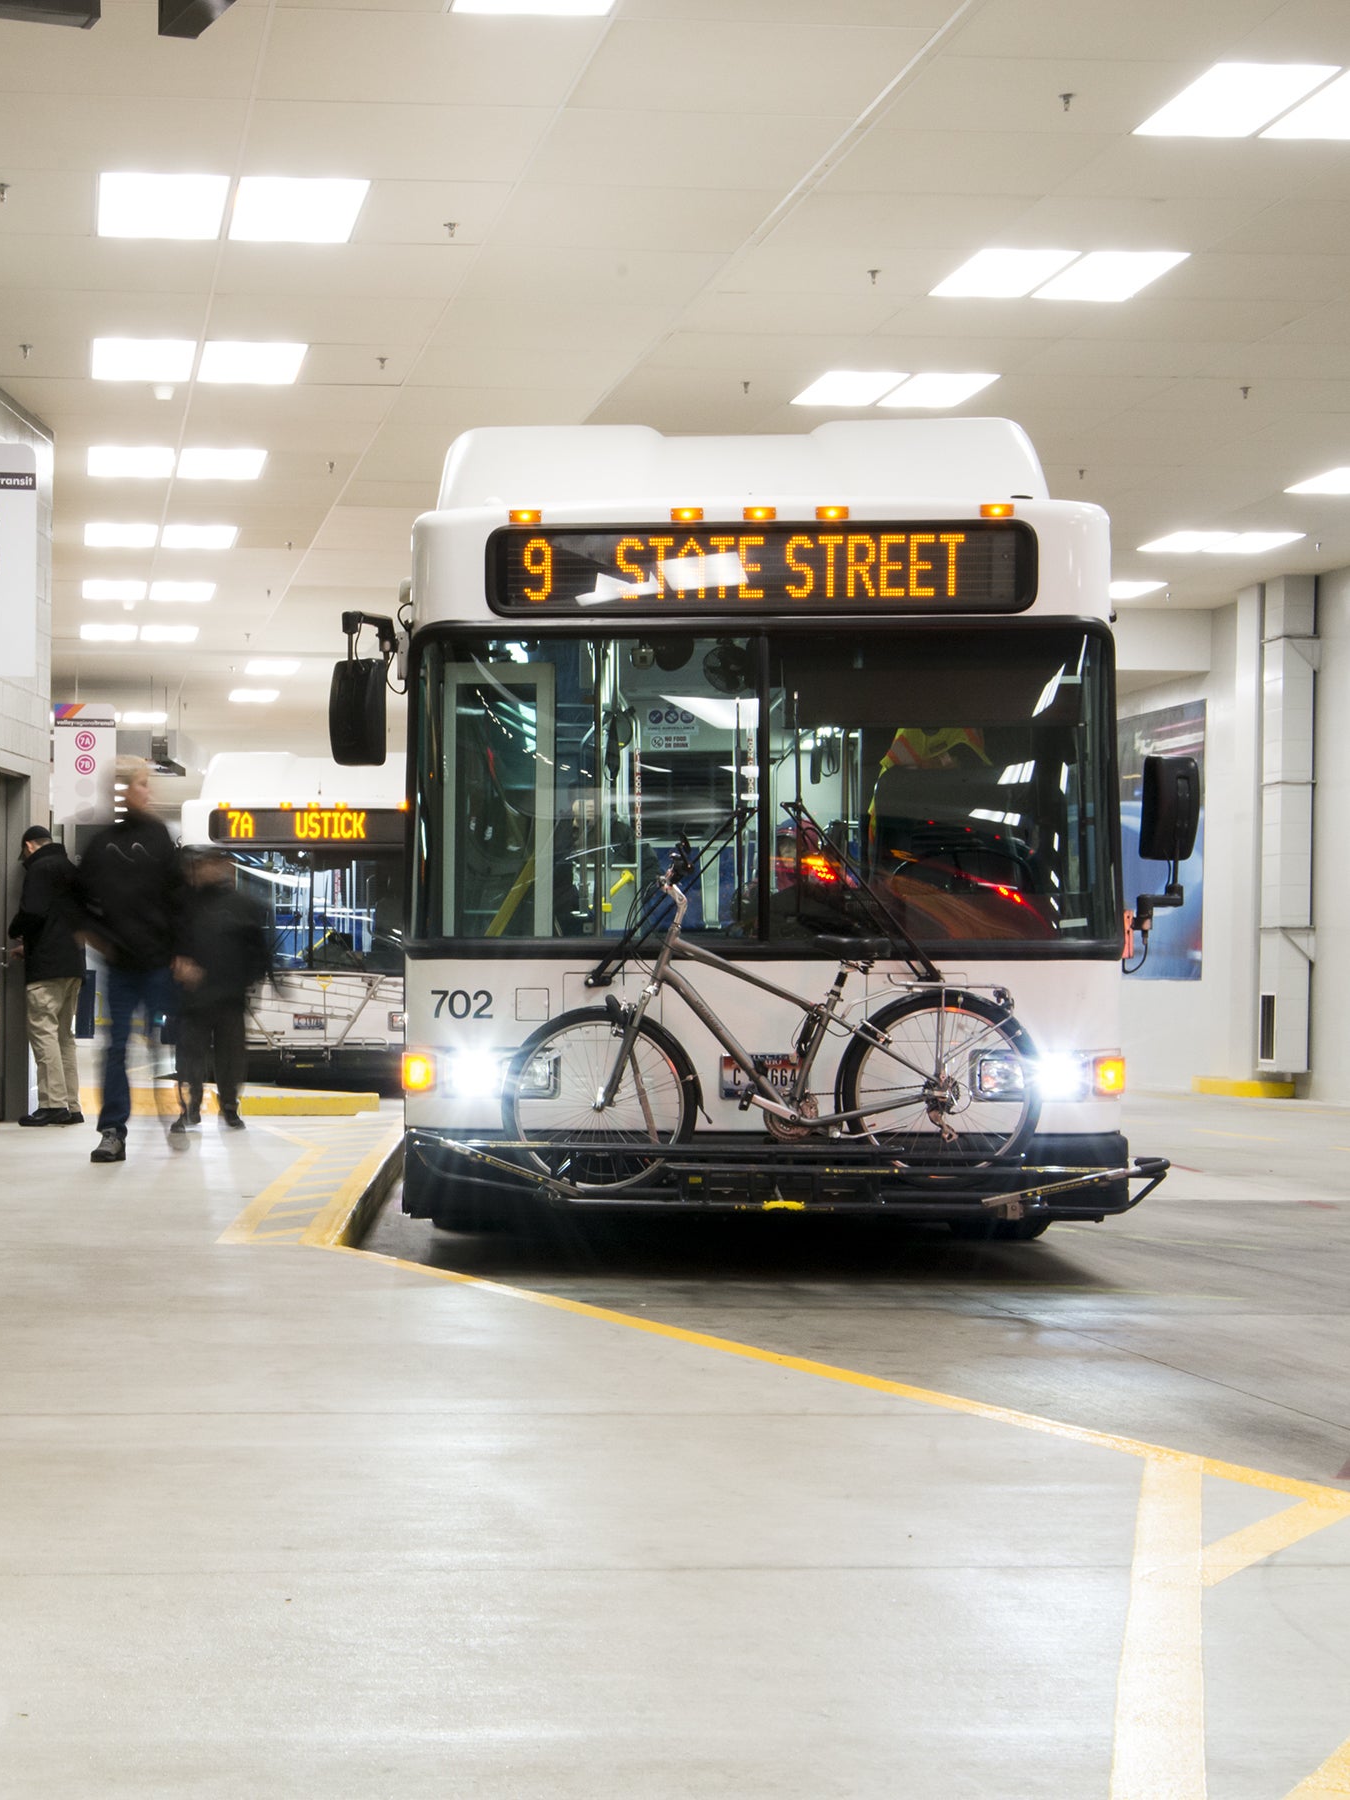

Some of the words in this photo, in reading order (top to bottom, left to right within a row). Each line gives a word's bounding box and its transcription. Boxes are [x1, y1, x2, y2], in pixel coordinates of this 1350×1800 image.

[524, 538, 552, 601] 9
[616, 535, 765, 600] STATE
[785, 534, 965, 598] STREET
[80, 736, 90, 746] 7A
[80, 760, 90, 769] 7B
[227, 811, 255, 839] 7A
[295, 811, 366, 839] USTICK
[431, 989, 494, 1020] 702
